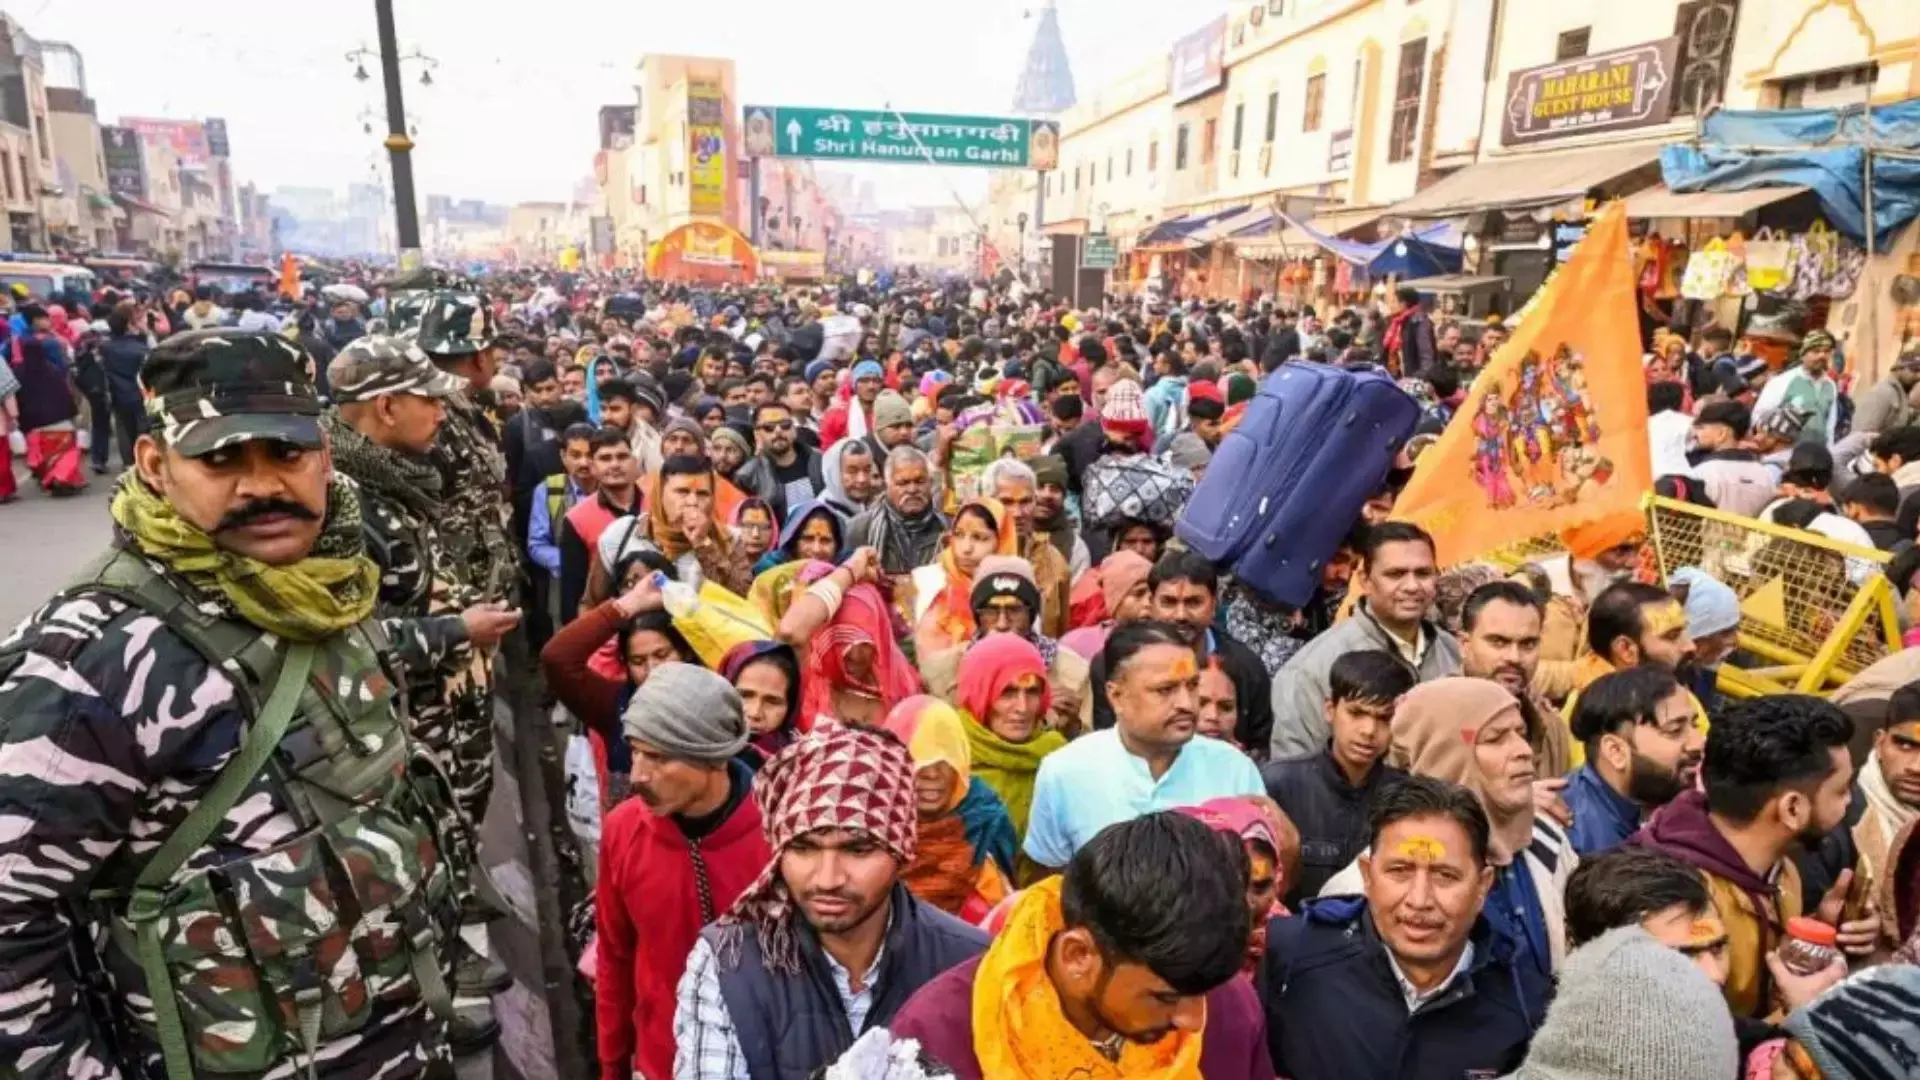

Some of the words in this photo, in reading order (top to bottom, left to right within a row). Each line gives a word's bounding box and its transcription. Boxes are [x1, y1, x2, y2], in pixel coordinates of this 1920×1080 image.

[1542, 64, 1632, 98] MAHARANI
[1534, 96, 1578, 118] GUEST
[1581, 87, 1633, 109] HOUSE
[813, 138, 855, 153] Shri
[861, 139, 960, 158] Hanuman
[964, 145, 1020, 162] Garhi
